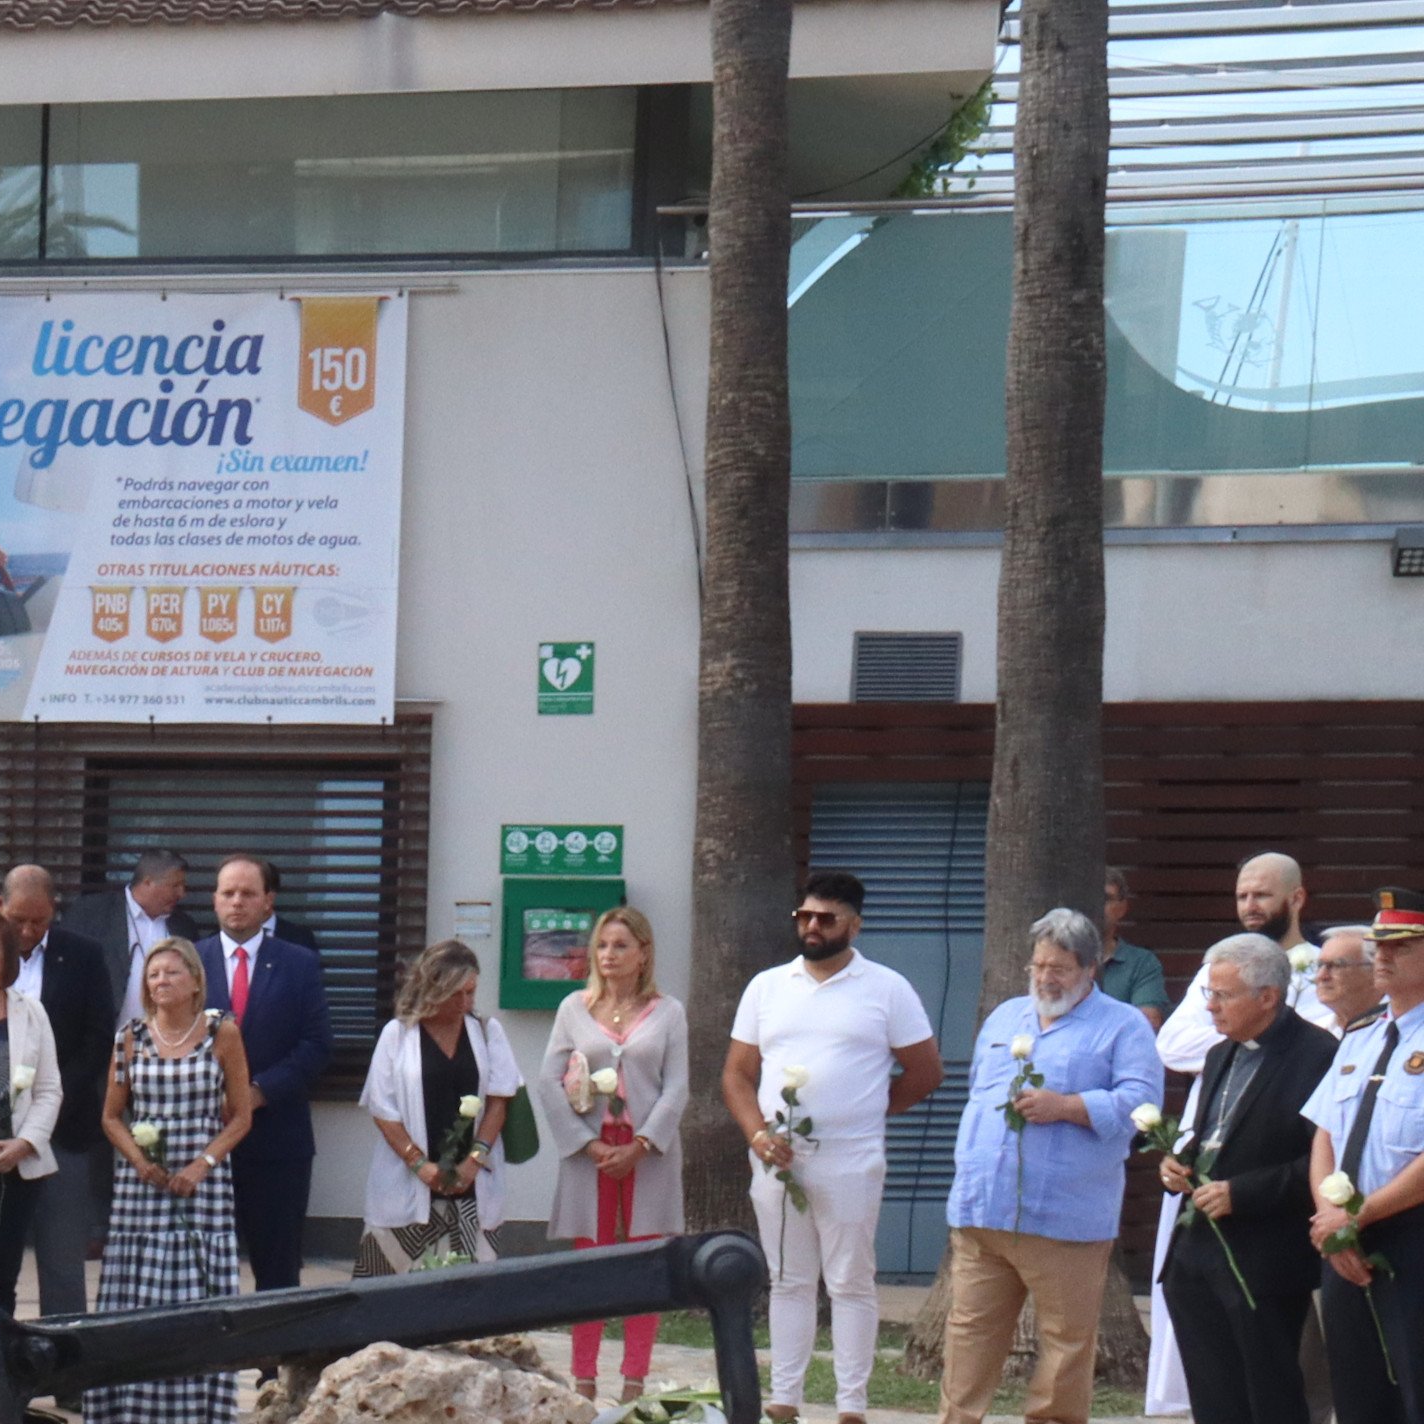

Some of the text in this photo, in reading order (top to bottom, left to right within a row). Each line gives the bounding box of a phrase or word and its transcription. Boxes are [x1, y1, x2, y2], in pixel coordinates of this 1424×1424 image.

[31, 318, 264, 377] licencia
[308, 347, 367, 391] 150
[330, 394, 343, 416] €
[216, 449, 370, 474] ¡Sin examen!
[177, 480, 240, 494] navegar
[242, 479, 270, 491] con
[118, 496, 339, 512] embarcaciones a motor y vela
[112, 514, 287, 530] de hasta 6 m de eslora y
[110, 533, 361, 549] todas las clases de motos de agua.
[97, 561, 340, 577] OTRAS TITULACIONES NÁUTICAS:
[96, 593, 128, 614] PNB
[150, 593, 180, 614] PER
[208, 593, 230, 614] PY
[262, 593, 284, 614] CY
[68, 649, 120, 661] ADEMÁS
[122, 651, 140, 661] DE
[141, 651, 190, 662] CURSOS
[193, 651, 210, 662] DE
[214, 651, 245, 662] VELA
[250, 651, 257, 662] Y
[65, 663, 374, 677] NAVEGACIÓN DE ALTURA Y CLUB DE NAVEGACIÓN
[49, 693, 77, 703] INFO
[118, 694, 140, 705] 977
[205, 695, 376, 706] www.clubnauticcambrils.com
